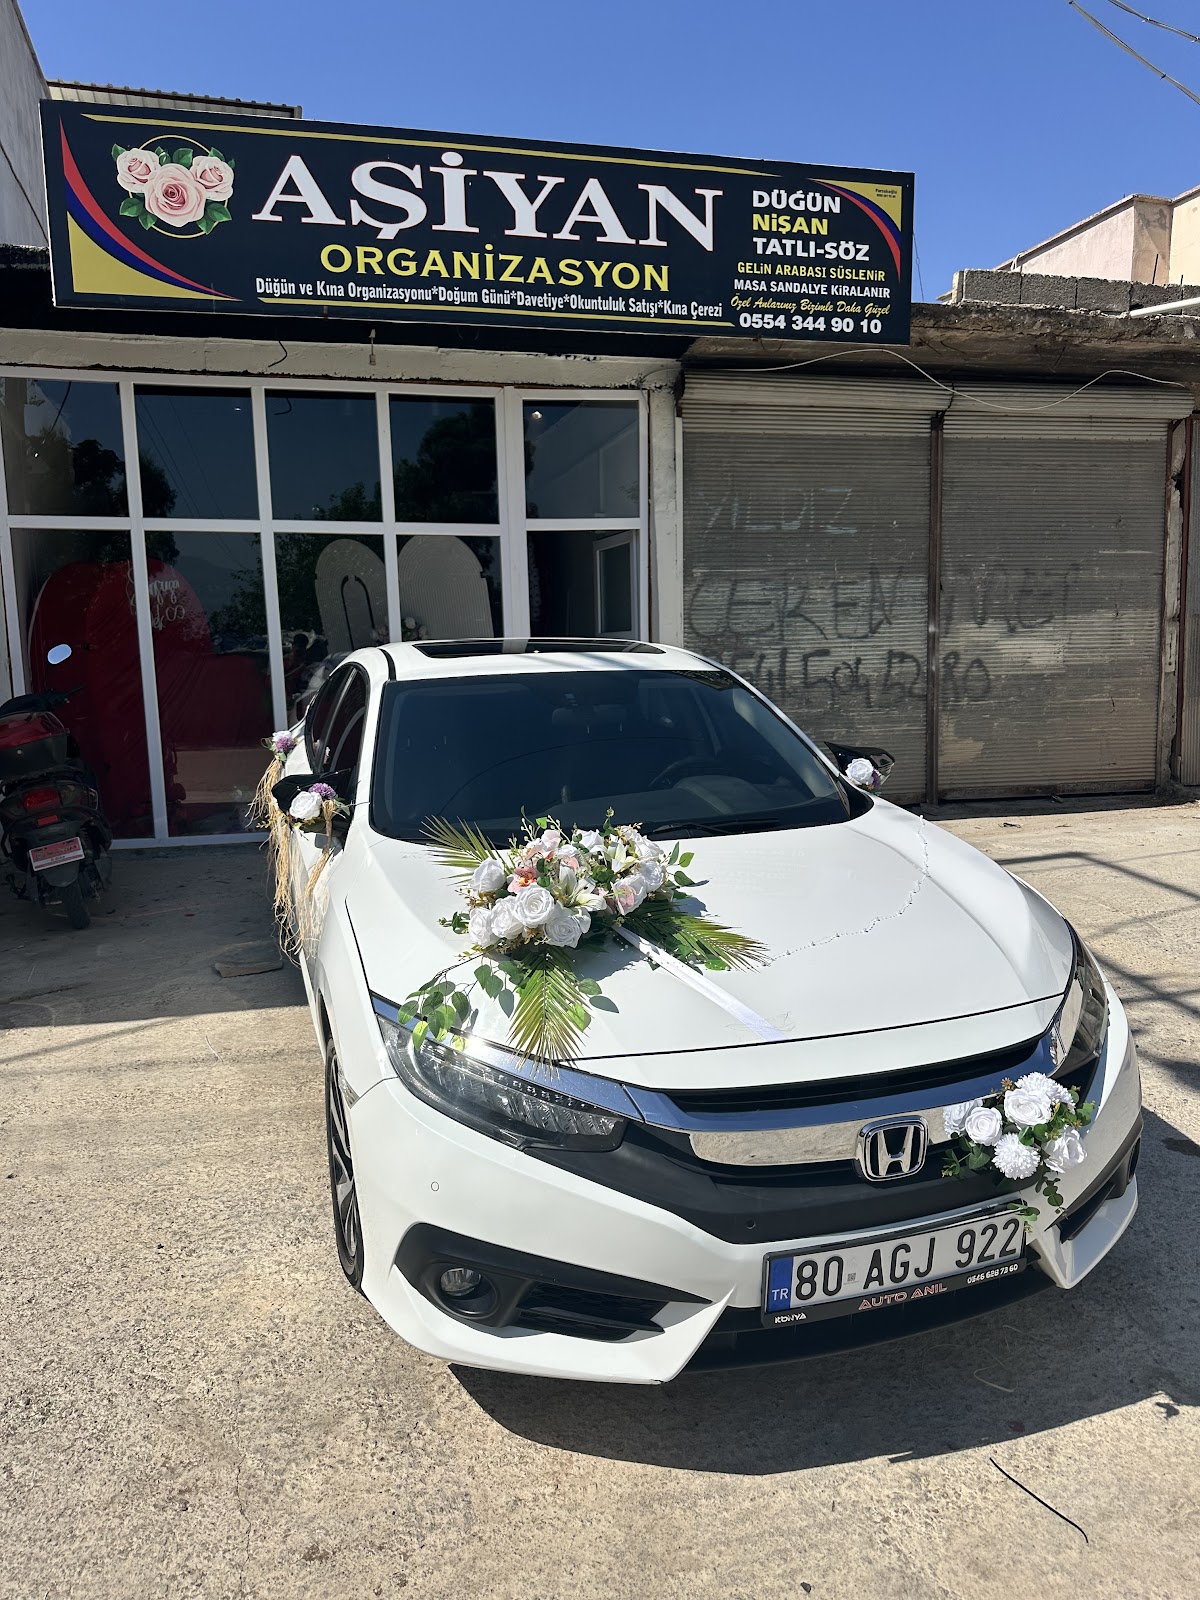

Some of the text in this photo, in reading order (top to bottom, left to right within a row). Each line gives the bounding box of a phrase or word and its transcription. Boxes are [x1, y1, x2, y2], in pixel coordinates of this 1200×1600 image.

[251, 151, 723, 251] AŞİYAN
[752, 189, 841, 214] DÜĞÜN
[752, 237, 870, 261] TATLI-SÖZ
[320, 243, 669, 291] ORGANİZASYON
[775, 264, 827, 278] ARABASI
[256, 277, 296, 296] Düğün
[298, 283, 313, 296] ve
[316, 280, 345, 297] Kına
[690, 301, 723, 319] Çerezi
[734, 279, 767, 292] MASA
[769, 282, 828, 295] SANDALYE
[730, 293, 752, 310] Özel
[800, 299, 834, 315] Bizimle
[836, 300, 861, 314] Daha
[864, 302, 890, 318] Güzel
[739, 312, 882, 334] 0554 344 90 10
[771, 1218, 1020, 1301] TR 80 AGJ 922
[774, 1312, 806, 1324] KONYA
[858, 1291, 908, 1311] AUTO
[911, 1283, 948, 1299] ANIL
